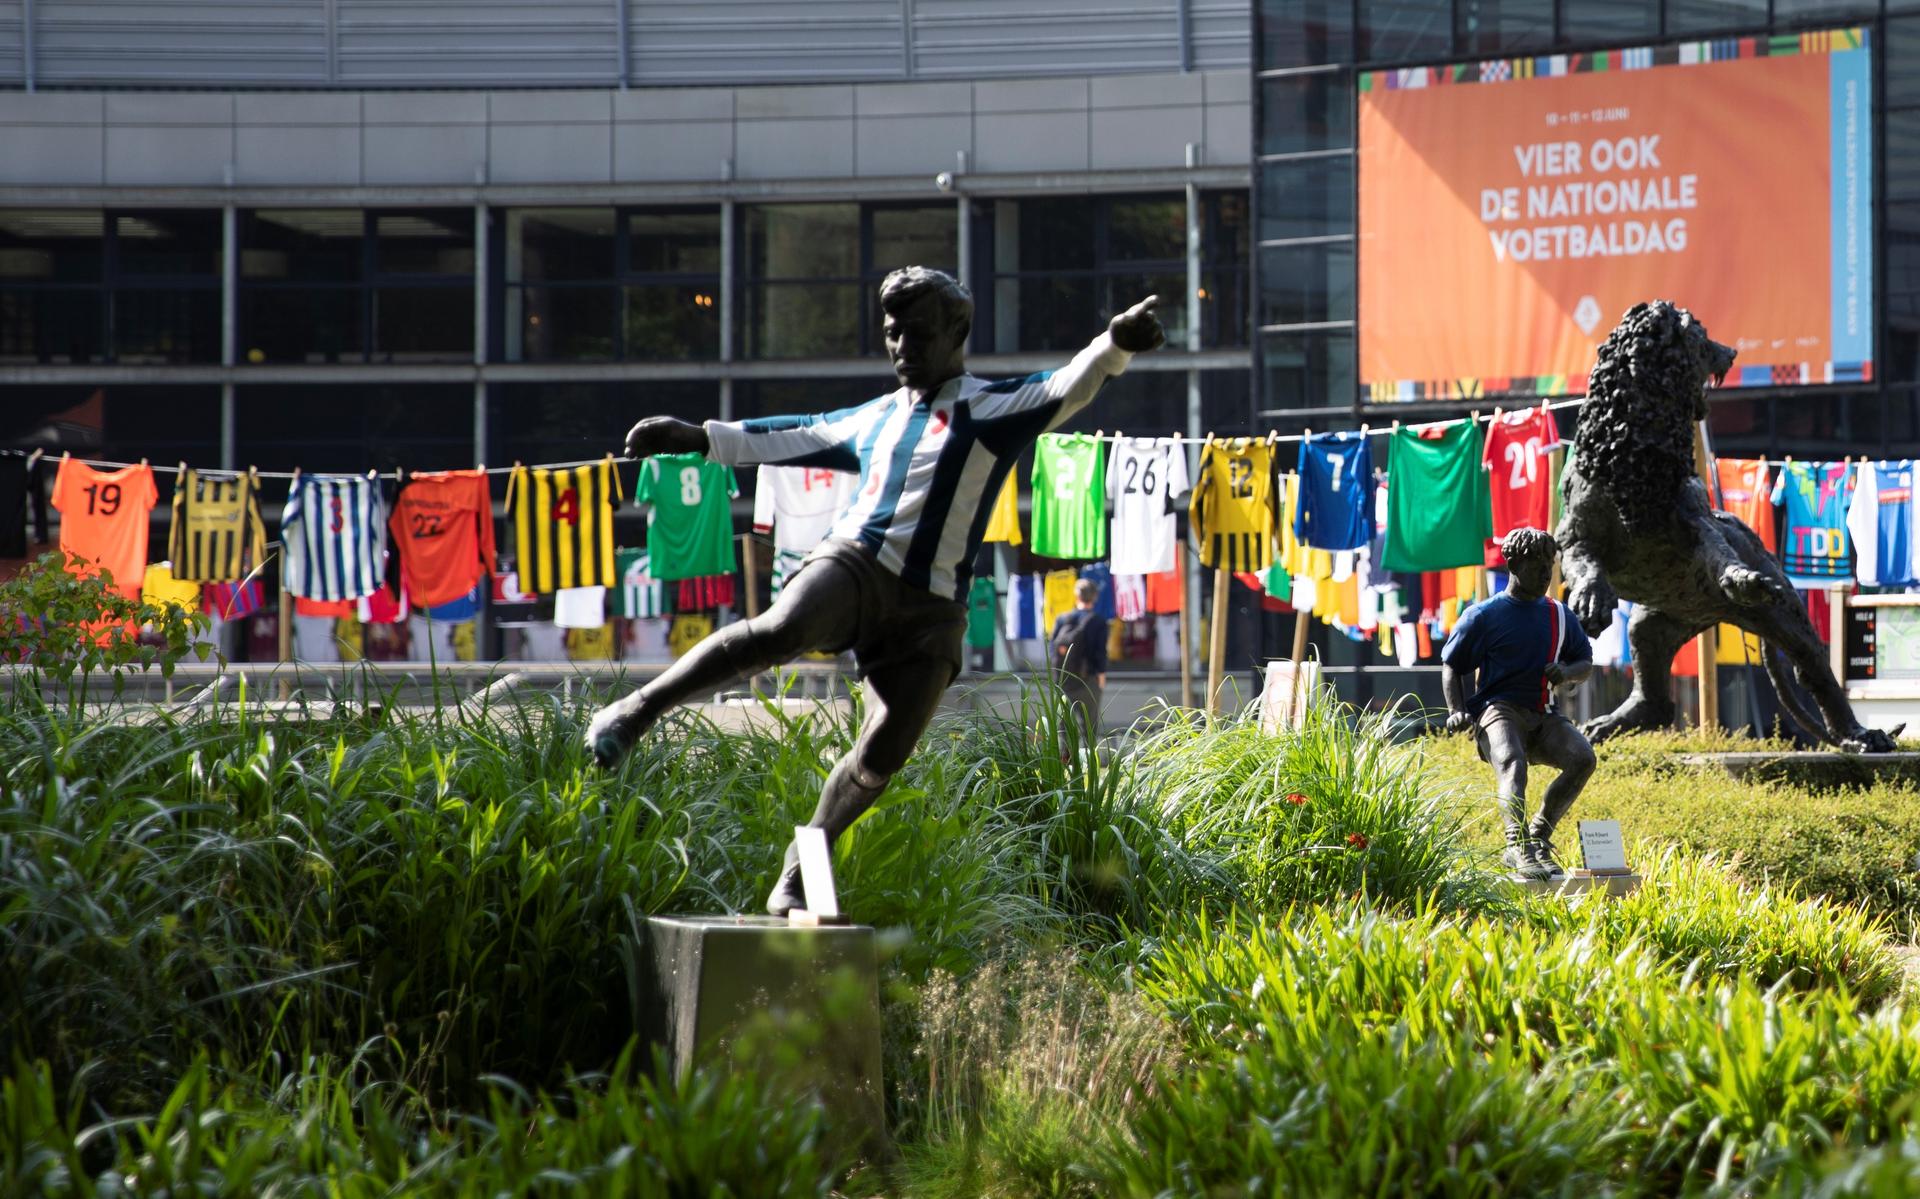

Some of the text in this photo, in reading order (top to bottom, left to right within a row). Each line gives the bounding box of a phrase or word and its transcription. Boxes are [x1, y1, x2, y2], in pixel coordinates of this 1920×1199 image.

[1514, 135, 1660, 177] VIER OOK
[1481, 175, 1698, 222] DE NATIONALE
[1489, 219, 1687, 263] VOETBALDAG
[1055, 458, 1077, 500] 2
[1124, 456, 1156, 496] 26
[1229, 457, 1253, 499] 12
[1326, 453, 1345, 492] 7
[1504, 437, 1537, 490] 20
[83, 484, 121, 516] 19
[680, 466, 702, 506] 8
[330, 497, 344, 533] 3
[412, 512, 445, 539] 22
[553, 489, 578, 526] 4
[1792, 526, 1844, 557] TDD
